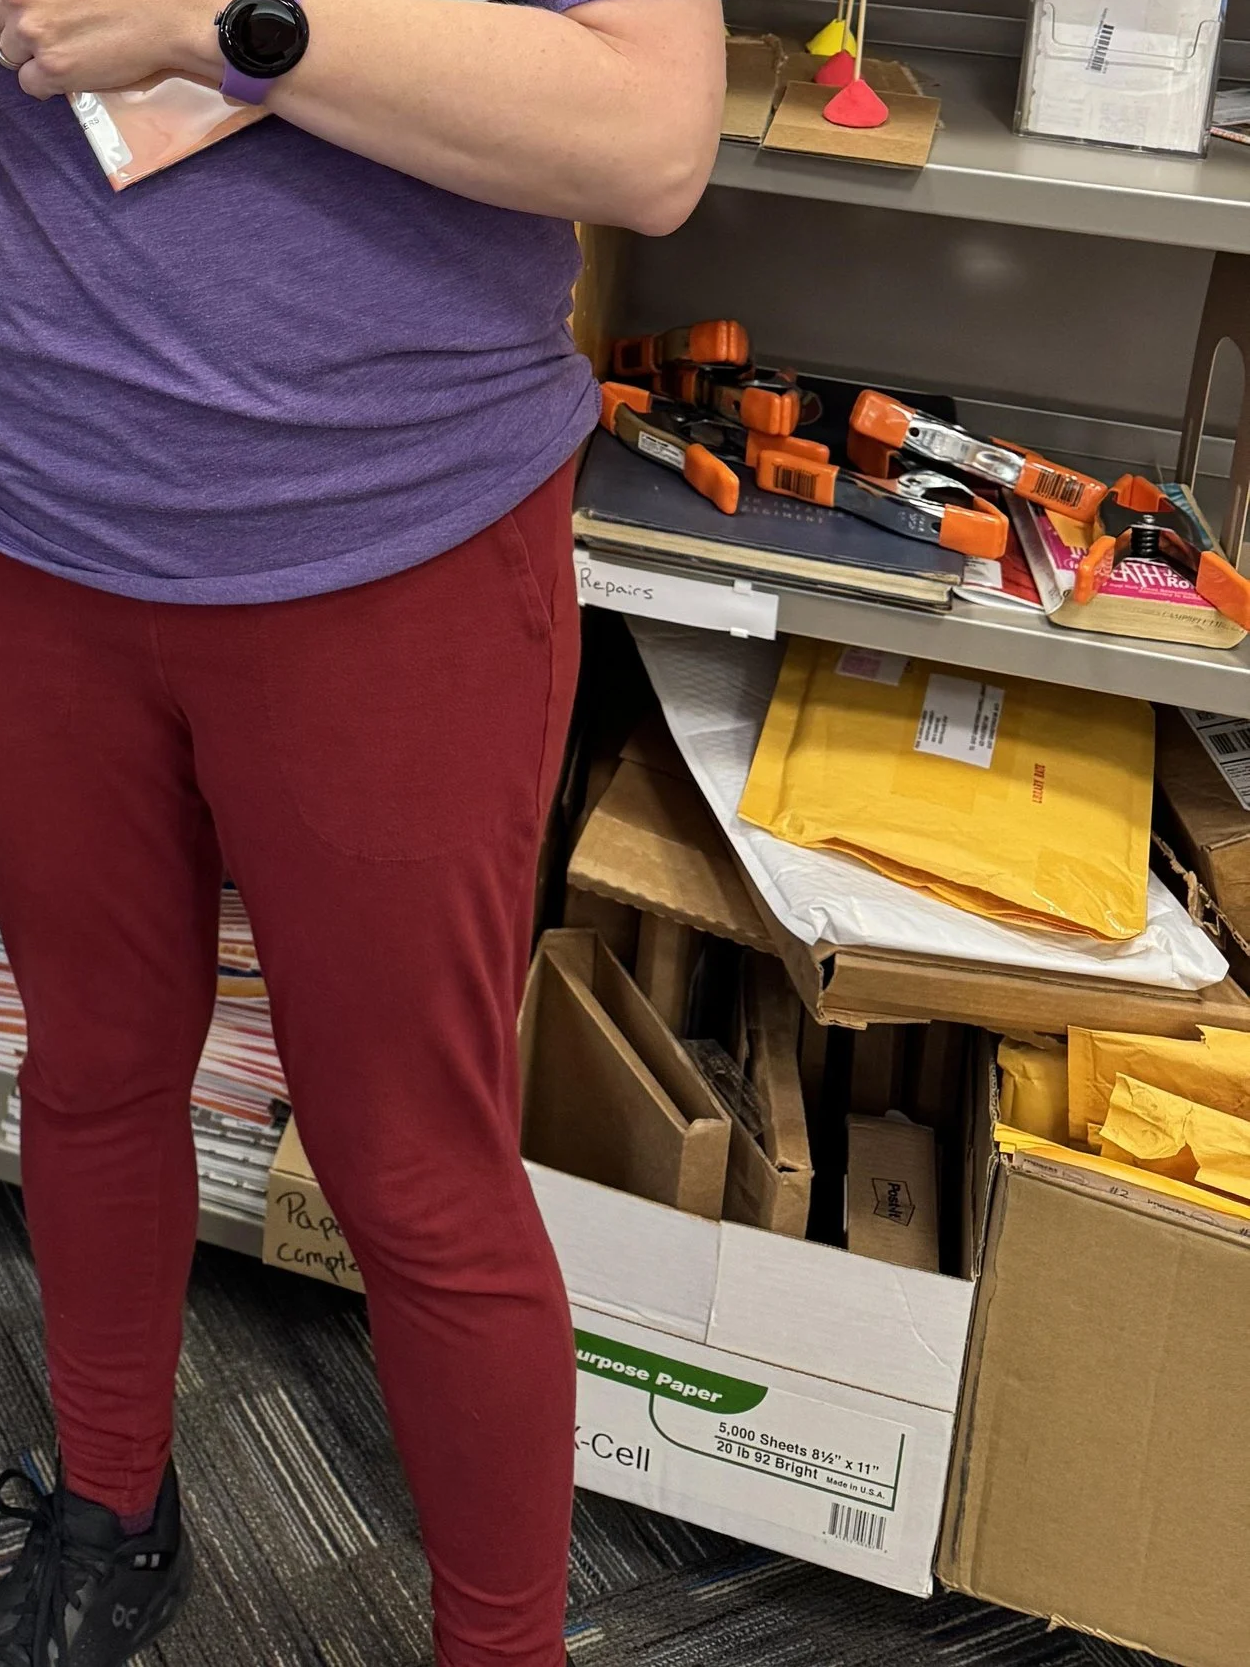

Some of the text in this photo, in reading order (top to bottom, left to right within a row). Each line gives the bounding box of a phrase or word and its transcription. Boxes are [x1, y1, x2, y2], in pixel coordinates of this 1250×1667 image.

[580, 567, 653, 600] Repairs
[575, 1349, 723, 1403] urpose Paper
[717, 1441, 885, 1500] 20 lb 92 Bright Made in U.S.A.
[719, 1421, 755, 1441] 5,000
[760, 1433, 808, 1457] Sheets
[845, 1460, 853, 1470] x
